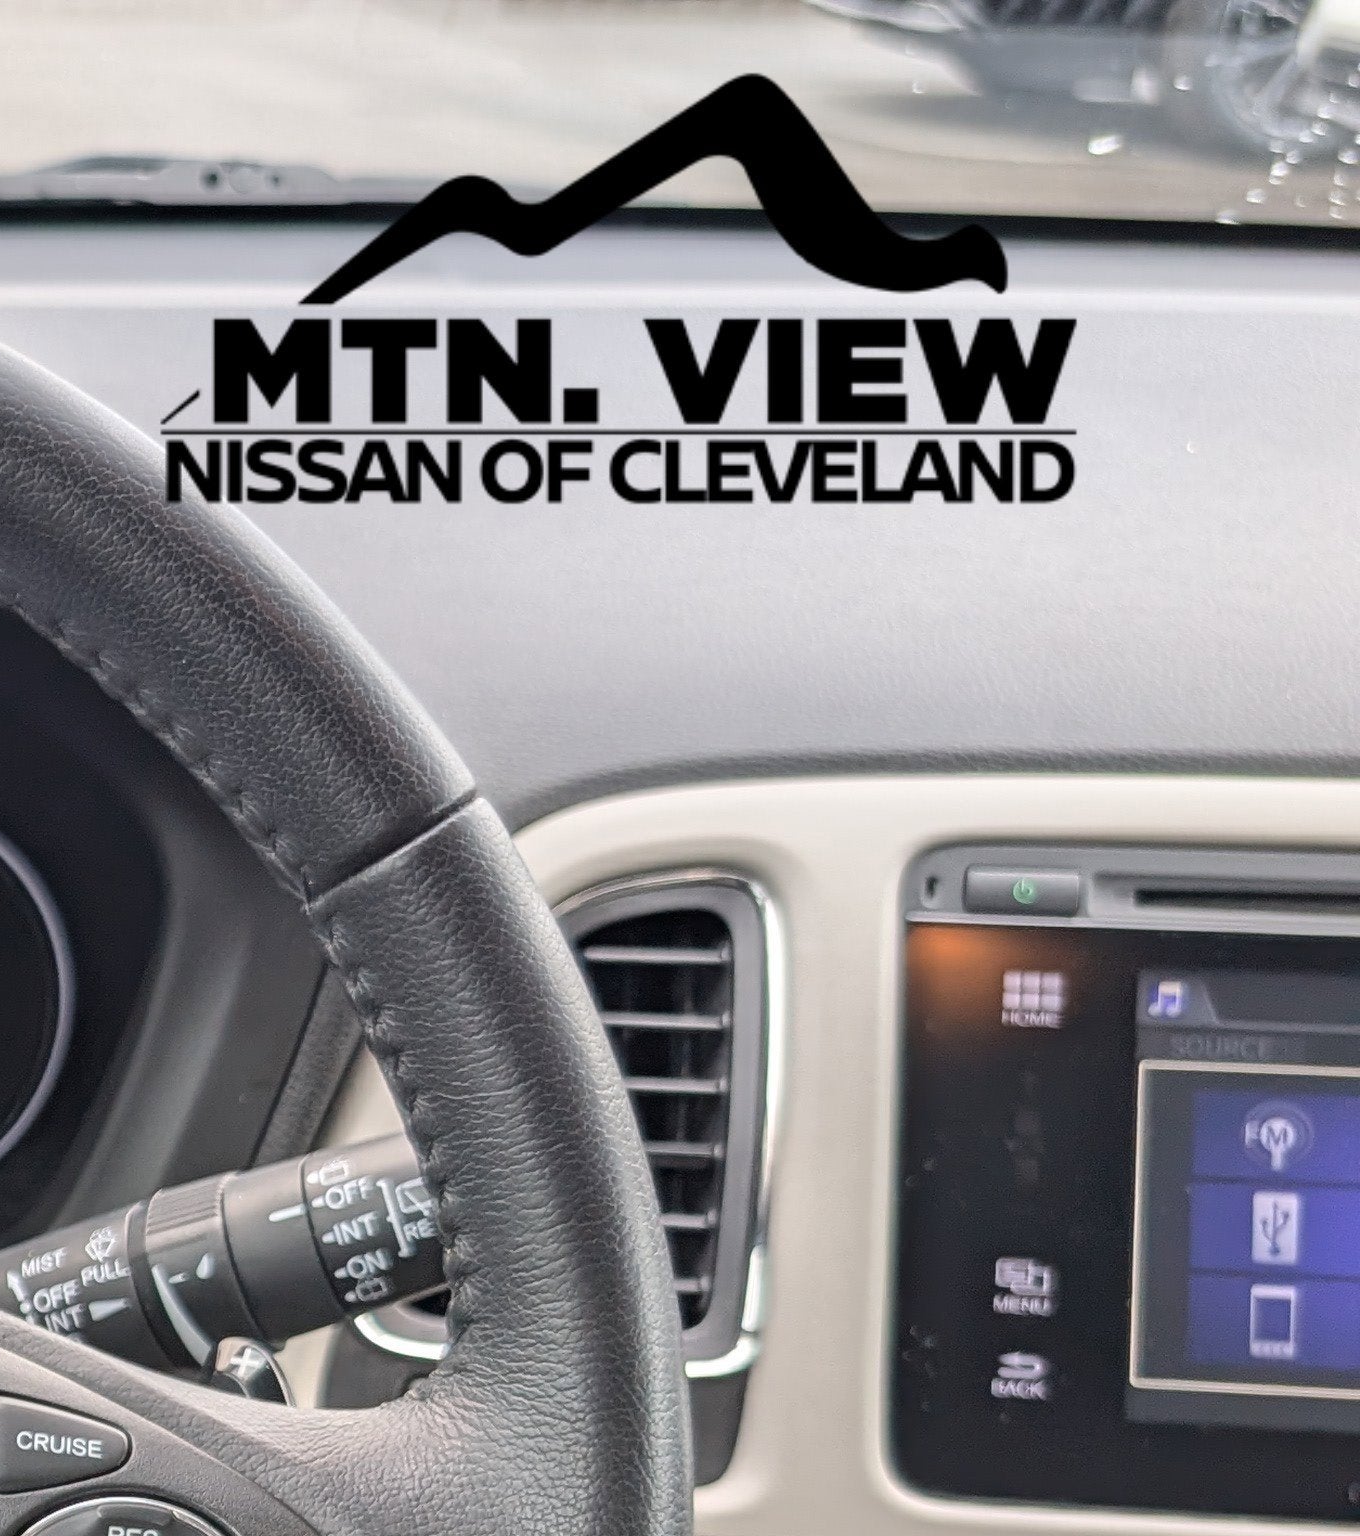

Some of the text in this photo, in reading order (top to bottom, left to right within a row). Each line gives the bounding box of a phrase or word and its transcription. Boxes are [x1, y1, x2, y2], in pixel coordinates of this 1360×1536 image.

[1001, 1009, 1061, 1029] HOME
[325, 1176, 374, 1210] OFF
[333, 1210, 378, 1246] INT
[21, 1246, 67, 1278] MIST
[81, 1256, 131, 1287] PULL
[347, 1248, 388, 1280] ON
[33, 1278, 80, 1313] OFF
[993, 1295, 1051, 1315] MENU
[44, 1302, 86, 1334] INT
[991, 1377, 1047, 1400] BACK
[15, 1430, 103, 1460] CRUISE
